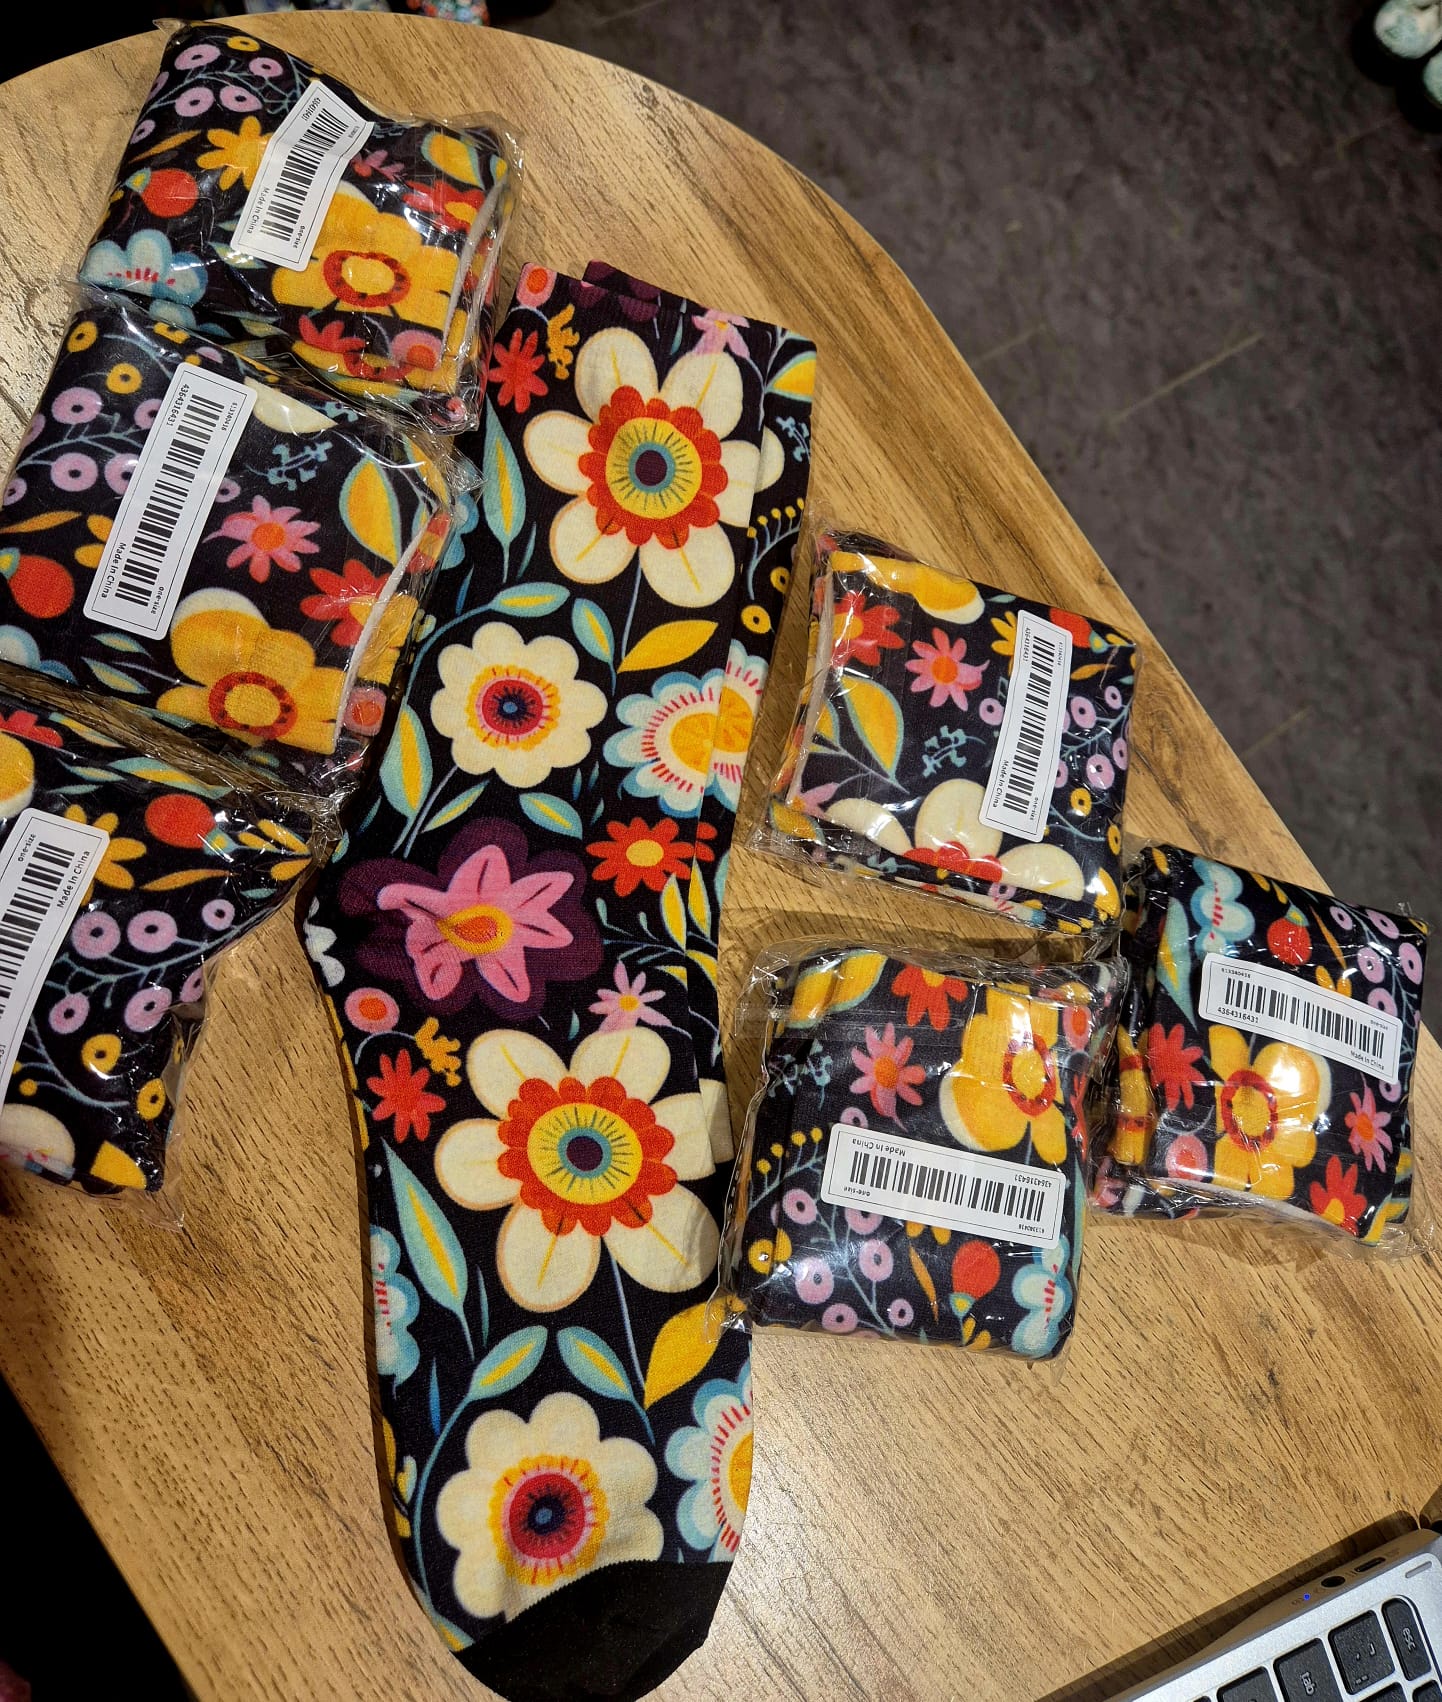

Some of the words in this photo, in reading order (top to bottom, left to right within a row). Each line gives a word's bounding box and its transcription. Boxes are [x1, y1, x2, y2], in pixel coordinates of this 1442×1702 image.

[166, 383, 190, 427] 4364316431
[112, 542, 127, 564] Made
[101, 574, 115, 599] China
[999, 759, 1009, 779] Made
[992, 787, 1003, 808] China
[56, 885, 74, 908] Made
[73, 850, 91, 875] China
[852, 1138, 874, 1150] China
[884, 1145, 906, 1157] Made
[1402, 1627, 1416, 1651] esc
[1300, 1671, 1317, 1695] tab
